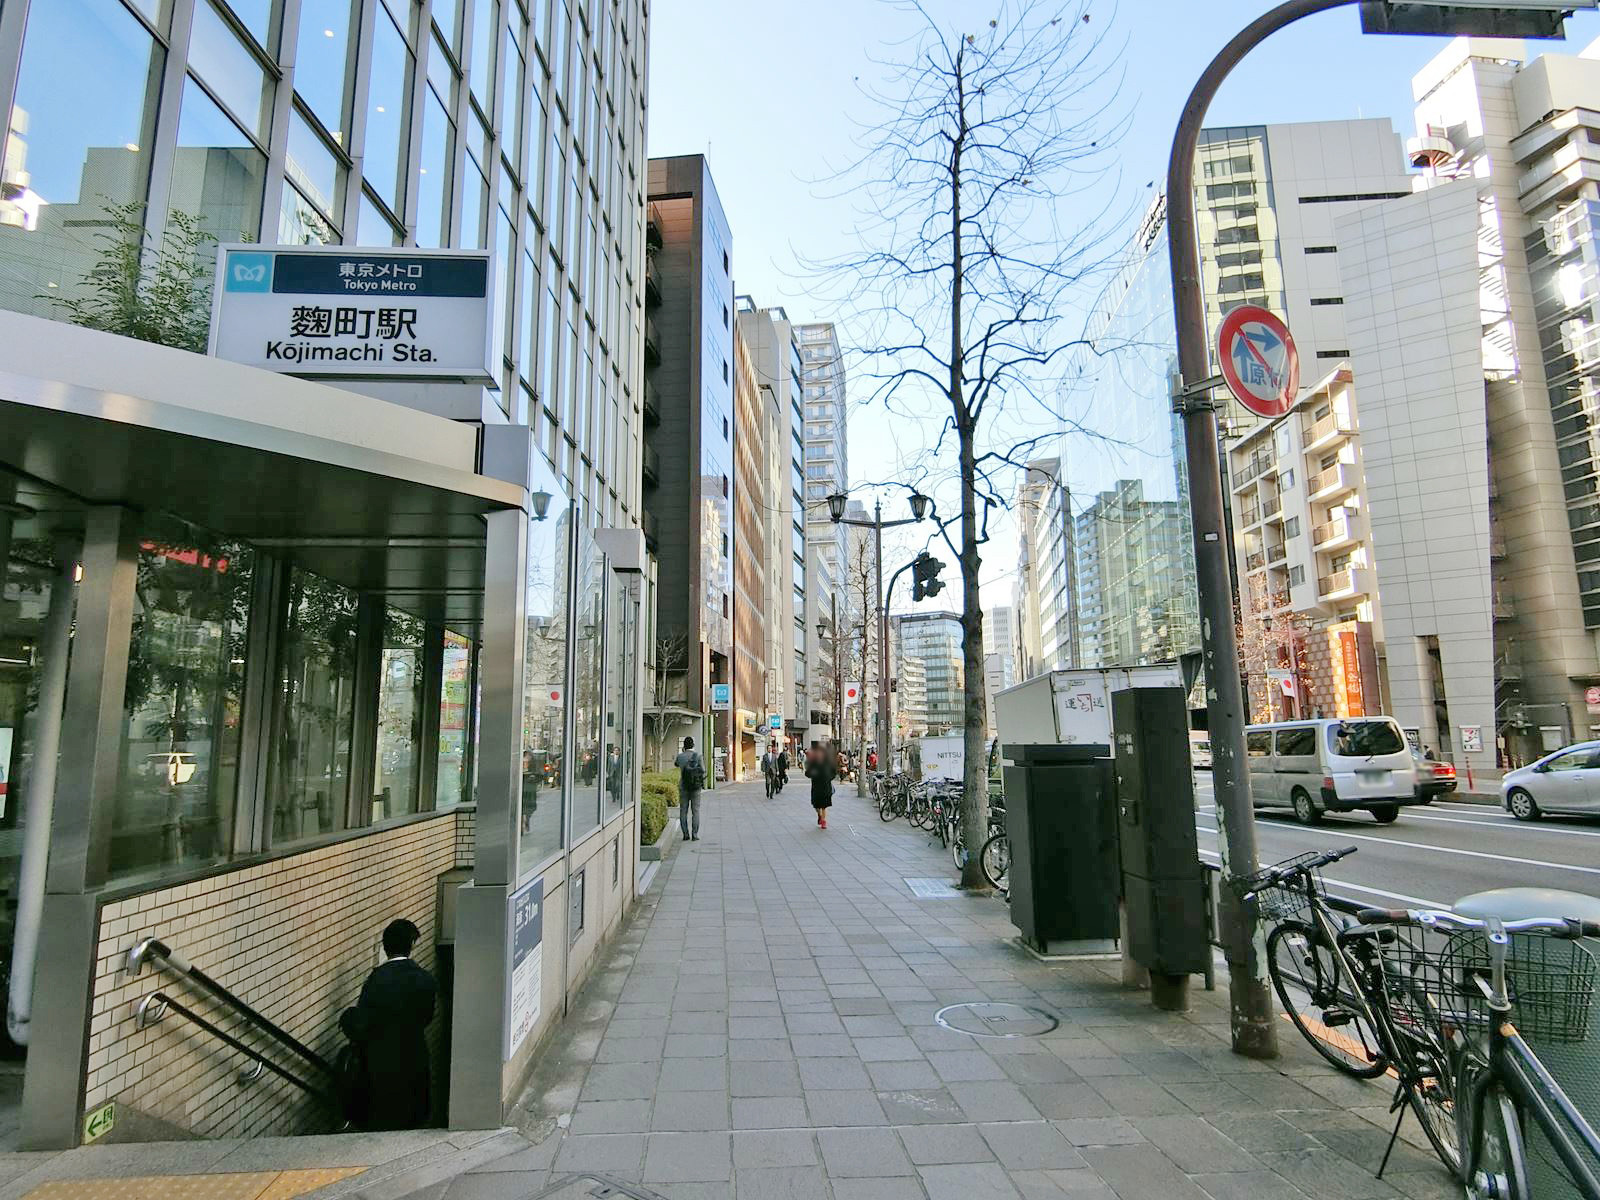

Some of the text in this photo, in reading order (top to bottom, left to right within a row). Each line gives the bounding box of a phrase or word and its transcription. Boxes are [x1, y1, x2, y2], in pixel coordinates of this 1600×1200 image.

[338, 262, 422, 278] 東京メトロ
[344, 279, 417, 292] Tokyo Metro
[266, 341, 438, 364] Kōjimachi Sta.
[937, 751, 962, 759] NITTSU
